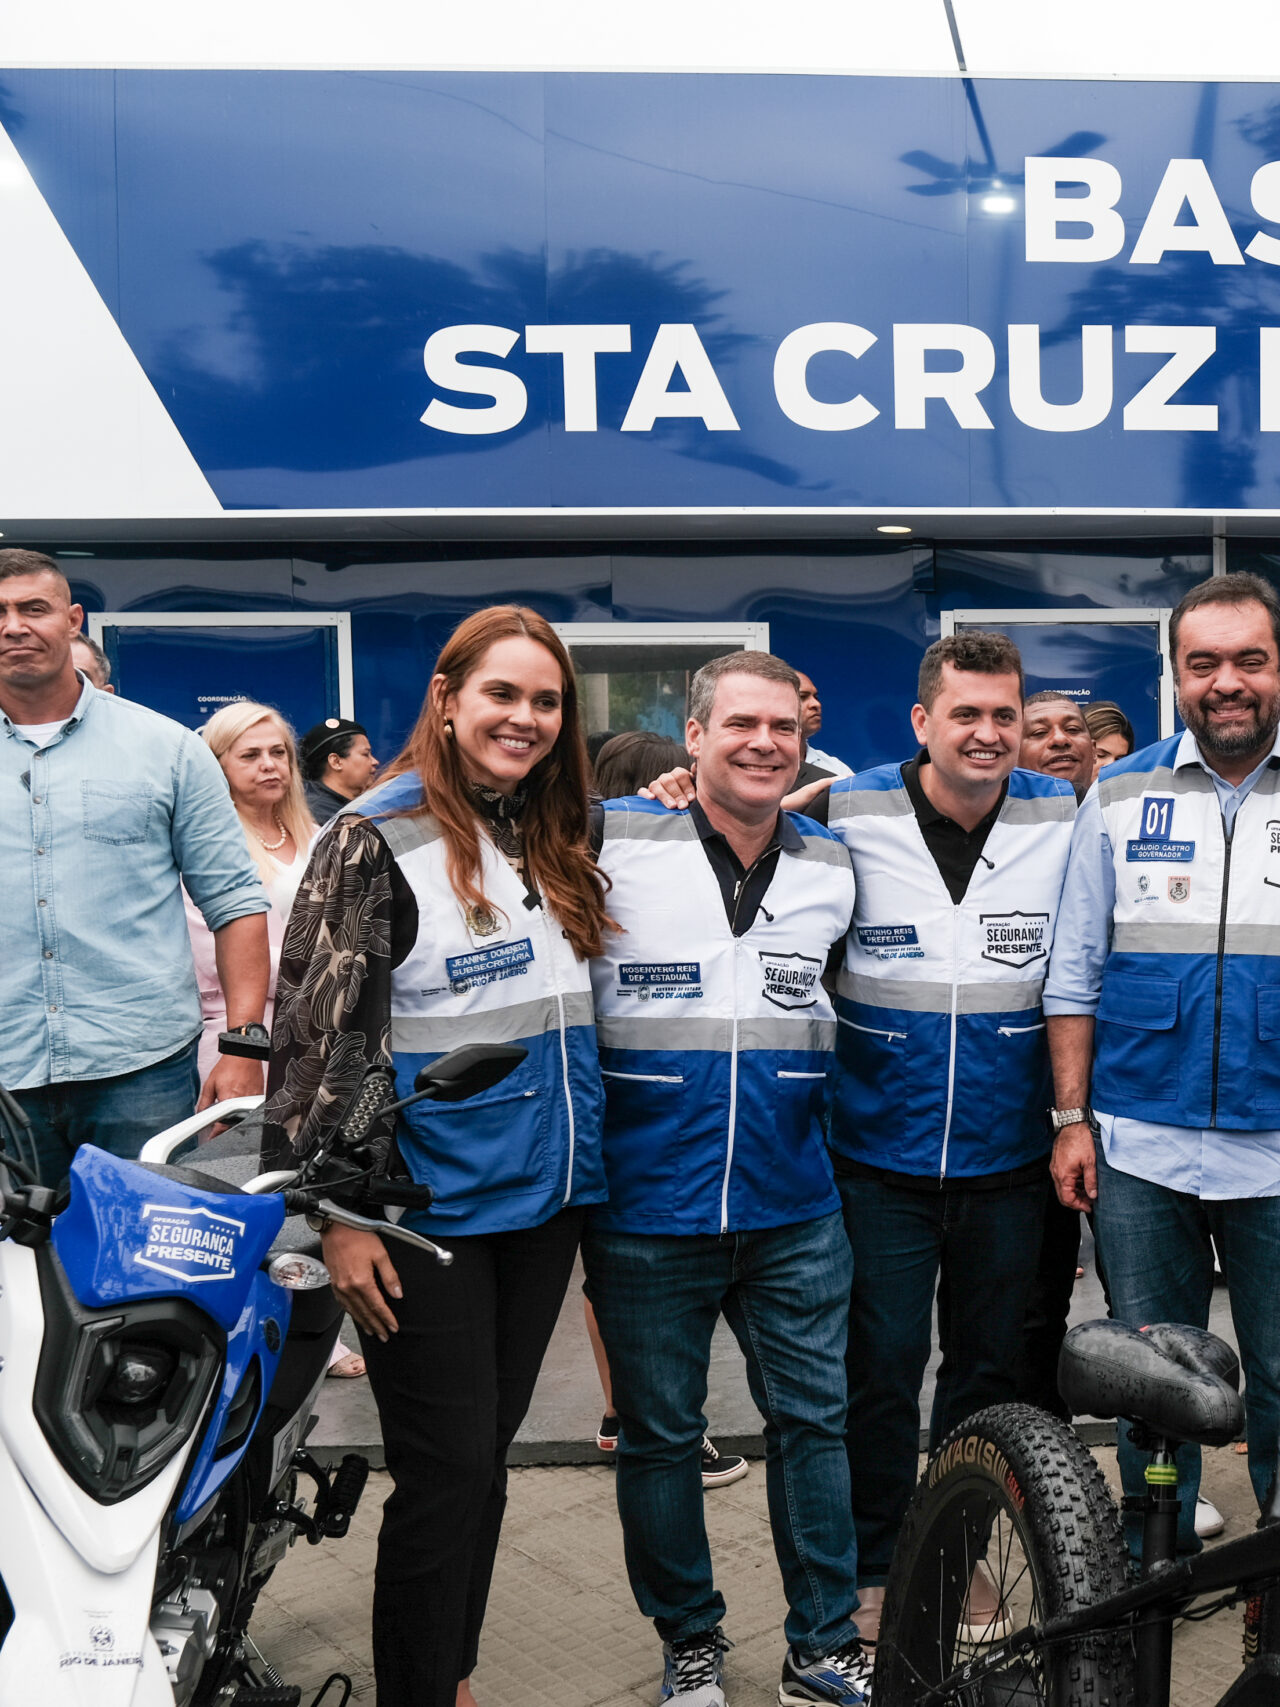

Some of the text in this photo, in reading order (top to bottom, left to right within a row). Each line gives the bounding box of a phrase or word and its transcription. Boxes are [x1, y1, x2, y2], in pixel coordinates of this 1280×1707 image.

[419, 323, 741, 435] STA
[773, 322, 1219, 432] CRUZ
[1146, 802, 1168, 835] 01
[867, 935, 906, 943] PREFEITO
[987, 928, 1044, 943] SEGURANÇA
[987, 943, 1042, 954] PRESENTE
[452, 953, 488, 968] JEANINE
[452, 951, 531, 977] SUBSECRETÁRIA
[622, 965, 697, 974] ROSENVERG REIS
[650, 973, 692, 981] ESTADUAL
[471, 978, 487, 988] RIO
[499, 967, 528, 981] JANEIRO
[674, 991, 703, 999] JANEIRO
[152, 1216, 190, 1226] OPERAÇÃO
[150, 1224, 234, 1256] SEGURANÇA
[145, 1244, 232, 1271] PRESENTE
